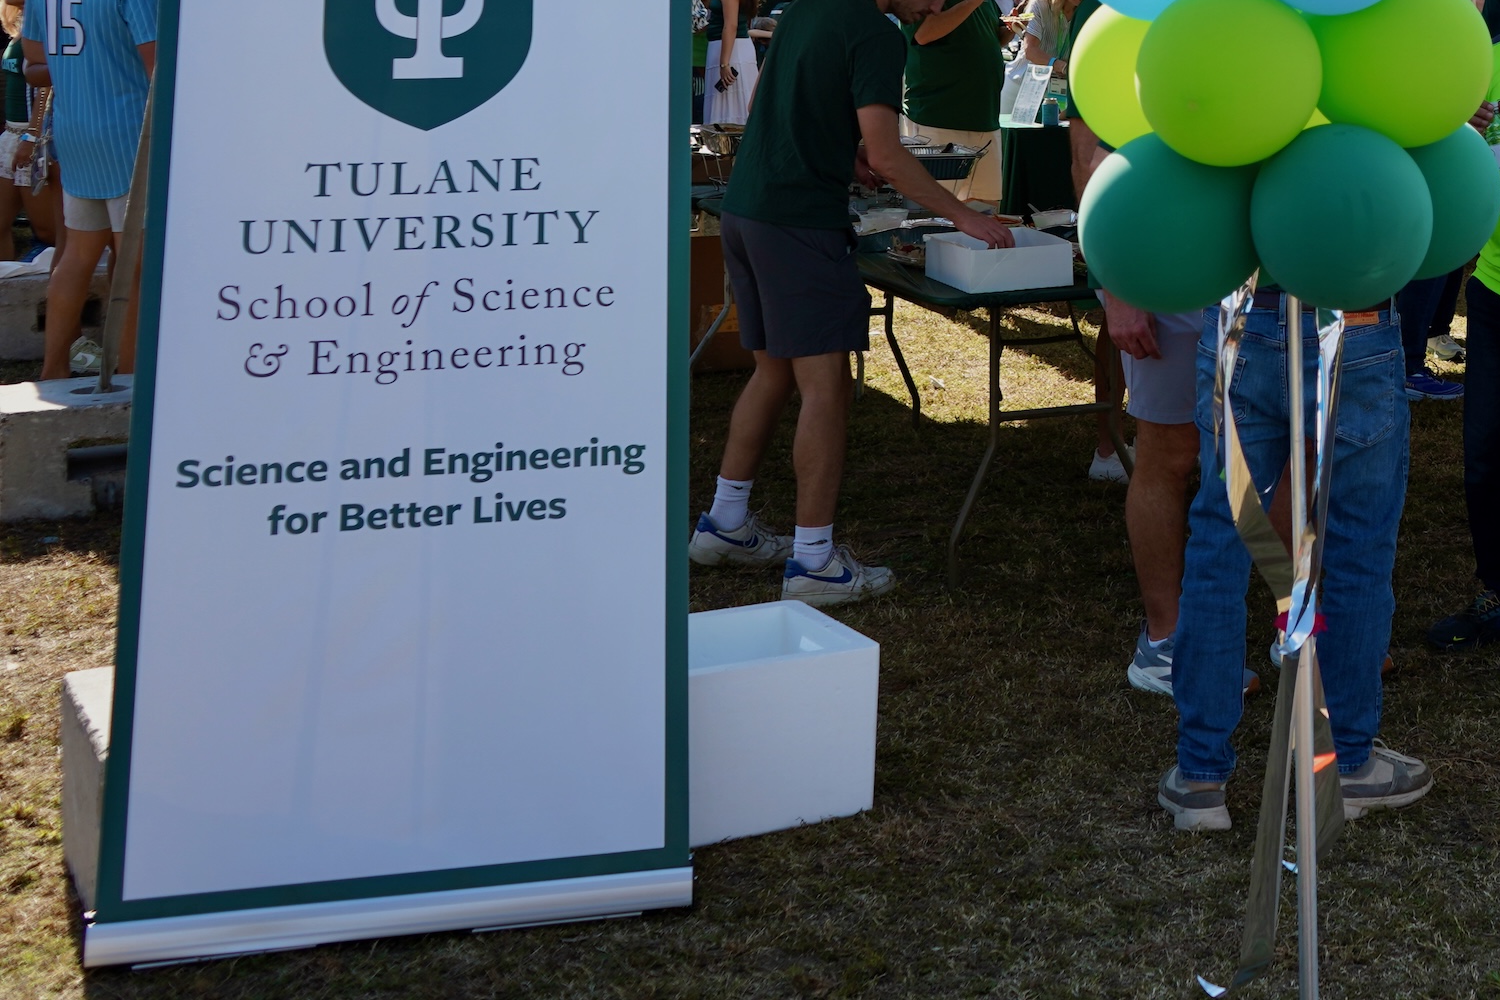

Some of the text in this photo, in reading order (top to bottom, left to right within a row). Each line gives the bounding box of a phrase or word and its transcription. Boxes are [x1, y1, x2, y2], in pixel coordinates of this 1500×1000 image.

[305, 156, 543, 198] TULANE
[239, 210, 601, 255] UNIVERSITY
[215, 277, 616, 328] School of Science
[244, 334, 587, 385] & Engineering
[175, 437, 647, 489] Science and Engineering
[267, 493, 567, 536] for Better Lives
